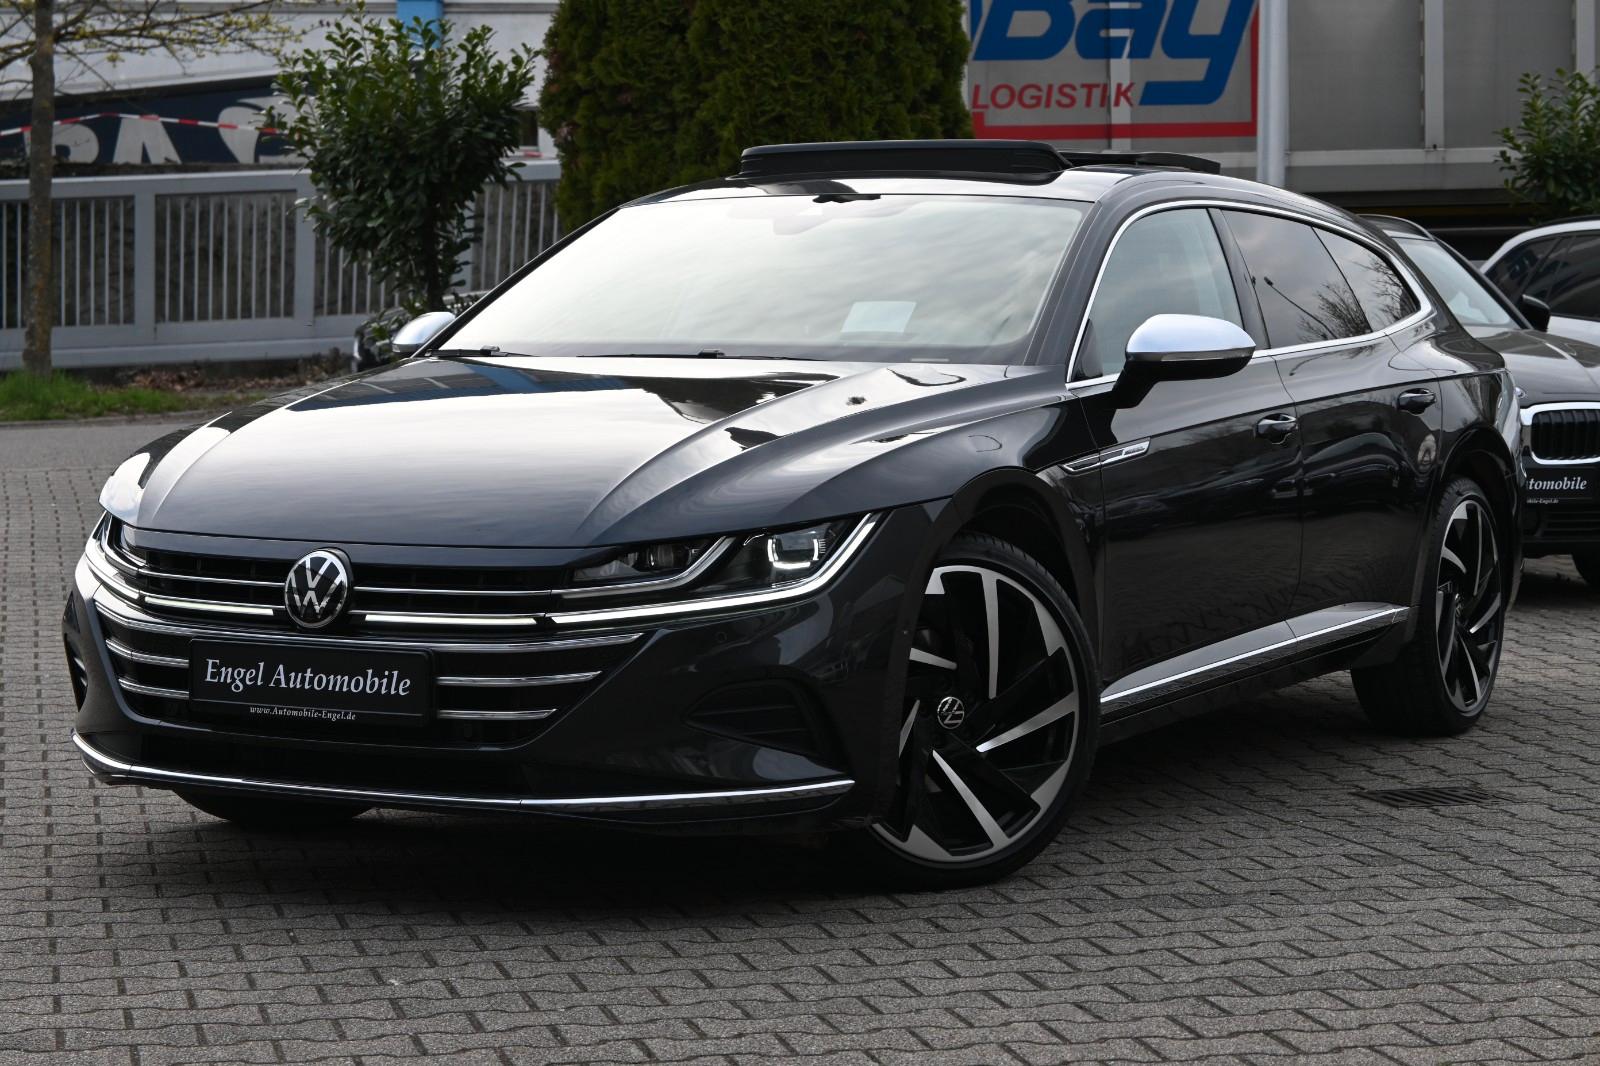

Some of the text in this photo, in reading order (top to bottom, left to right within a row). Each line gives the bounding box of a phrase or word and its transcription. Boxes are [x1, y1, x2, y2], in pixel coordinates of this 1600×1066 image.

[970, 0, 1259, 106] Bay
[972, 81, 1136, 110] LOGISTIK
[1526, 476, 1588, 490] tomobile
[205, 658, 411, 696] Engel Automobile
[249, 706, 356, 722] www.Automobile-Engel.de
